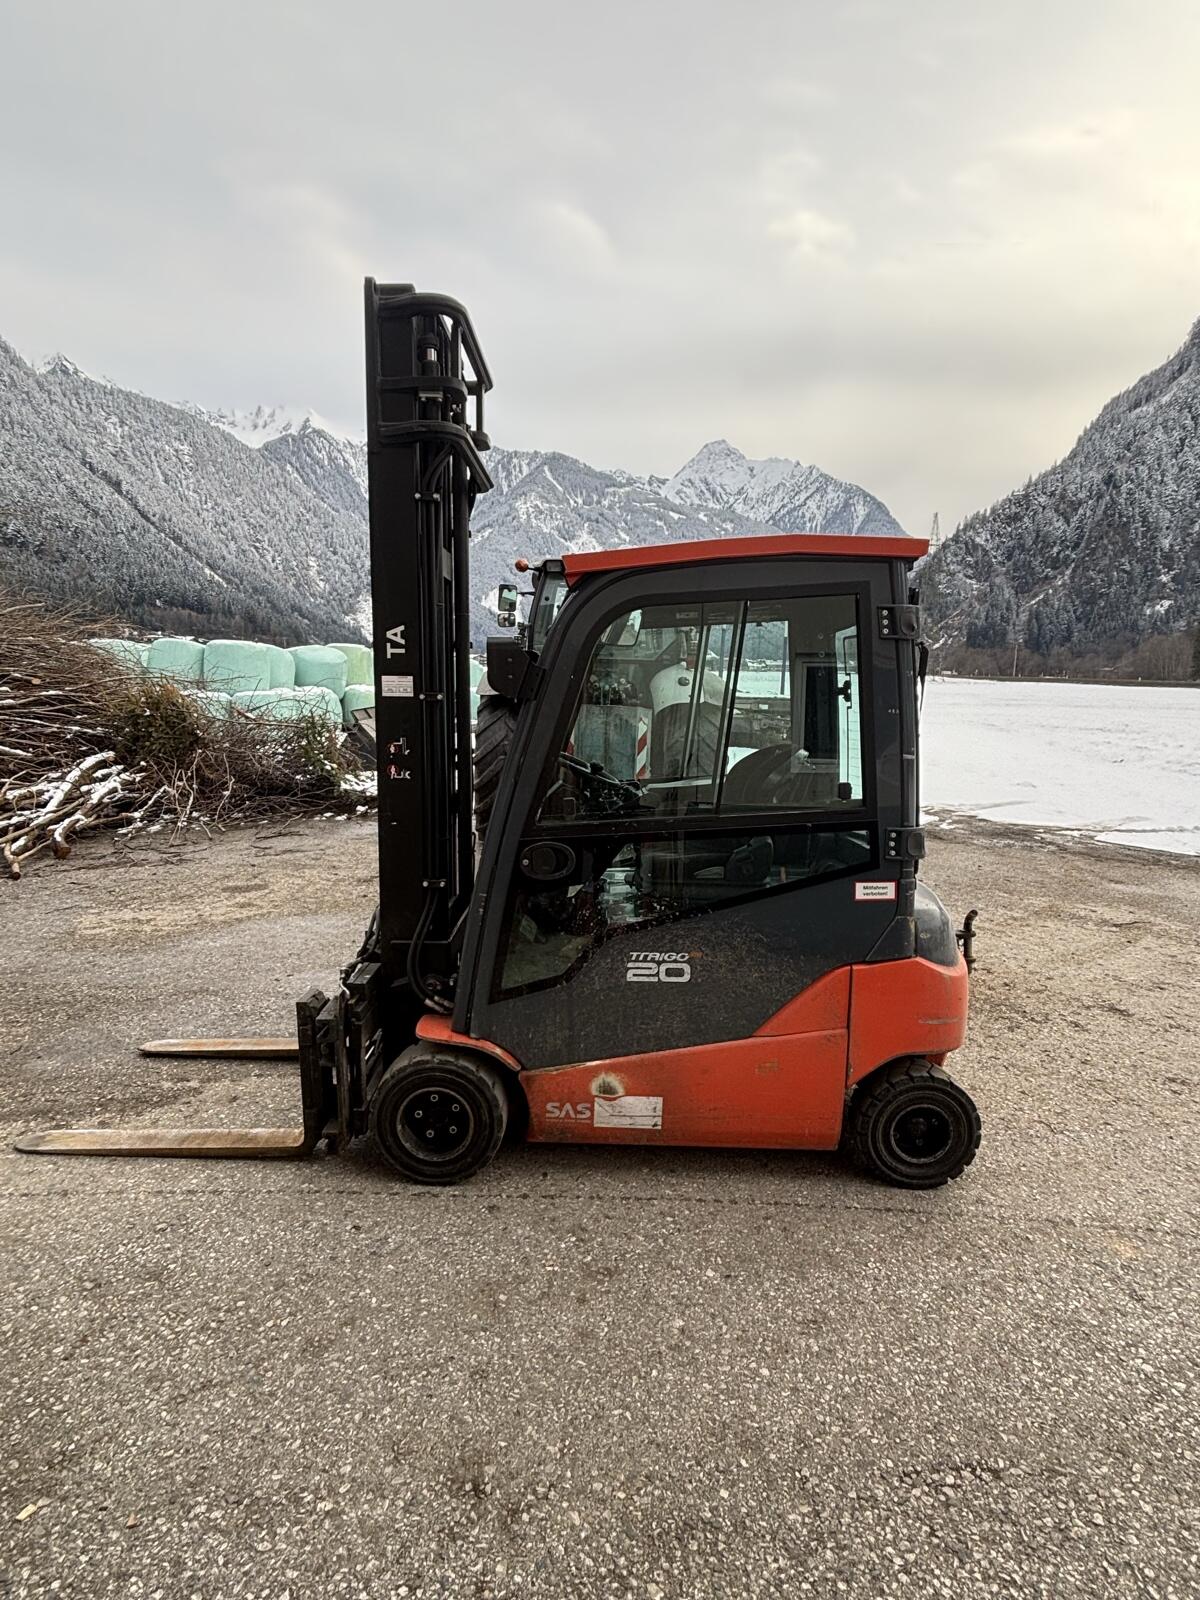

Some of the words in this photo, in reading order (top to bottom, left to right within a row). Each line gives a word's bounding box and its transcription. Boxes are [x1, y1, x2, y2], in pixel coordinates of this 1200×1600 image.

[386, 625, 406, 659] TA
[626, 962, 691, 983] 20
[545, 1102, 592, 1119] SAS
